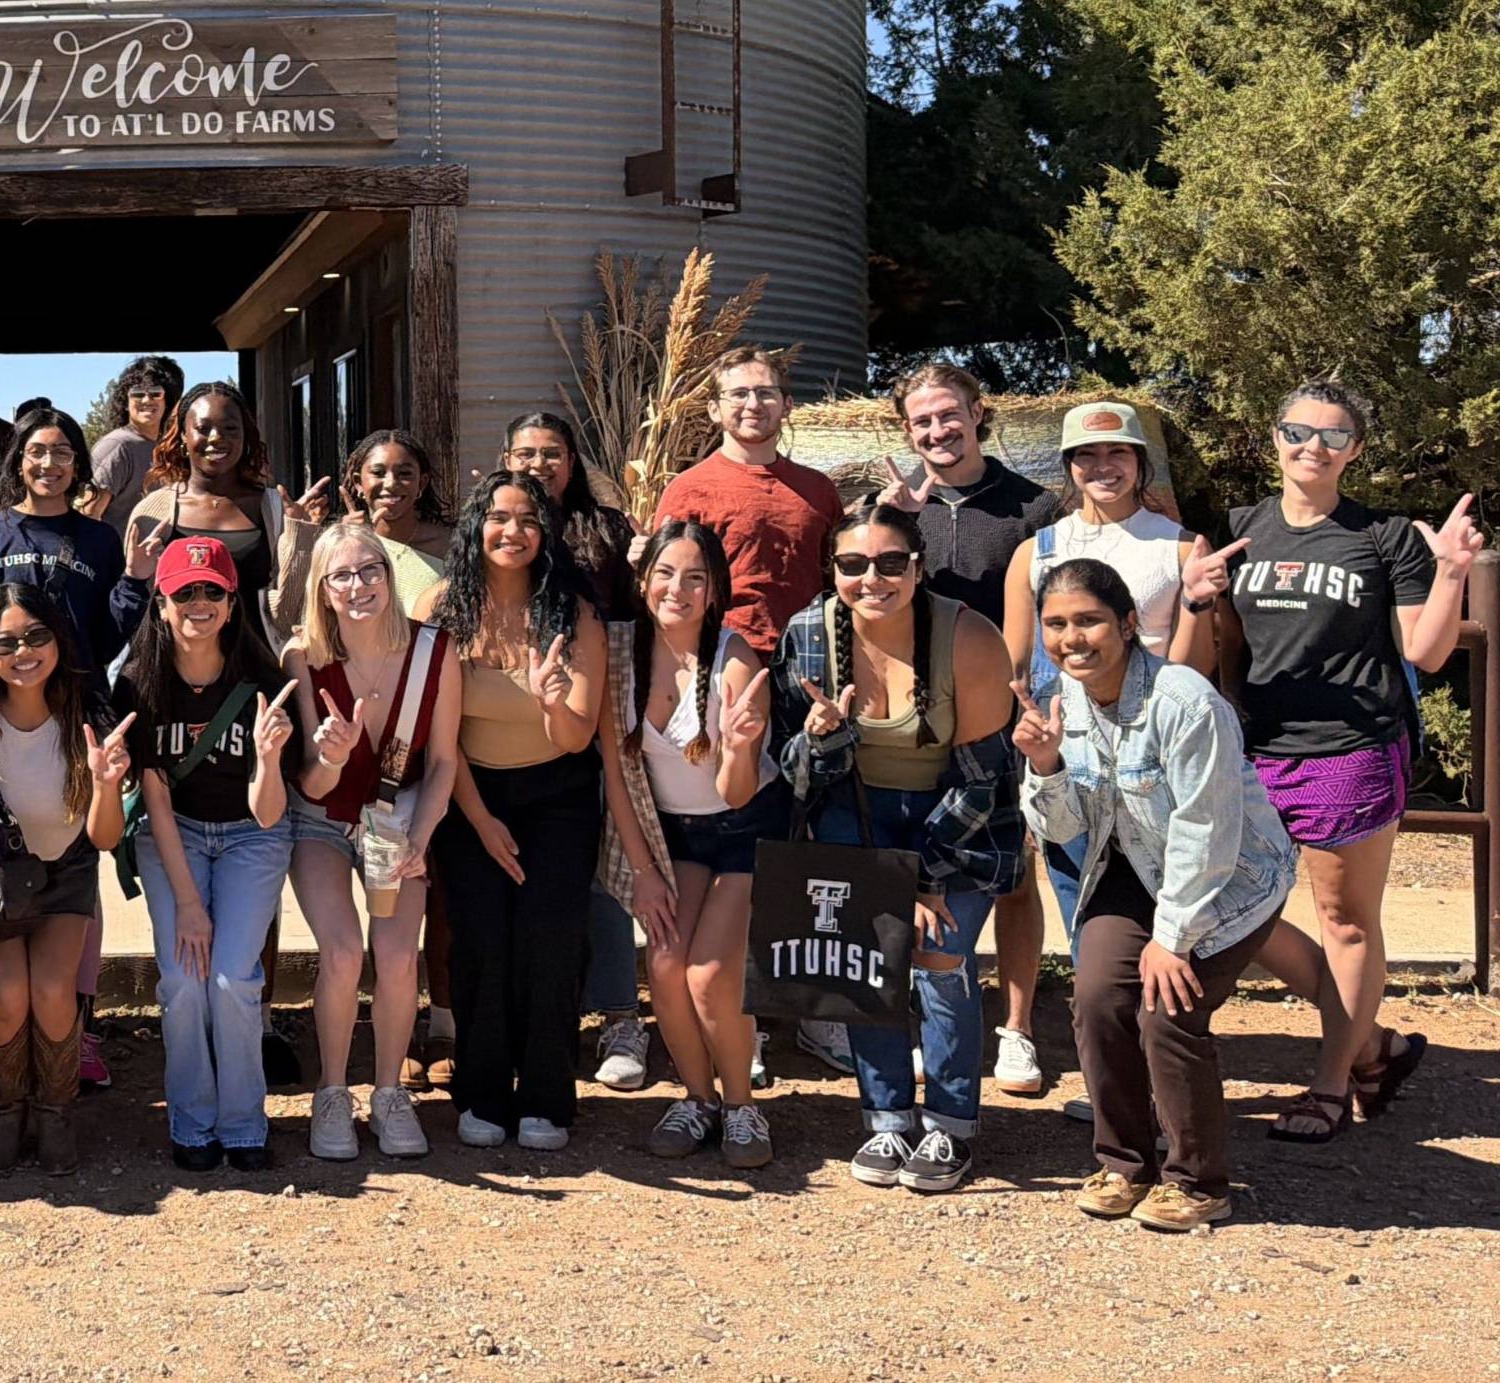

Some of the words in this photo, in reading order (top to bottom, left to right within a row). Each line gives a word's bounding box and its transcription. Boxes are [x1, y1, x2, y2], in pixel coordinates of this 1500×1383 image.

[62, 114, 100, 138] TO
[111, 112, 171, 136] AT'L
[182, 111, 223, 135] DO
[236, 108, 336, 134] FARMS
[1256, 599, 1308, 610] MEDICINE
[771, 938, 884, 989] TTUHSC
